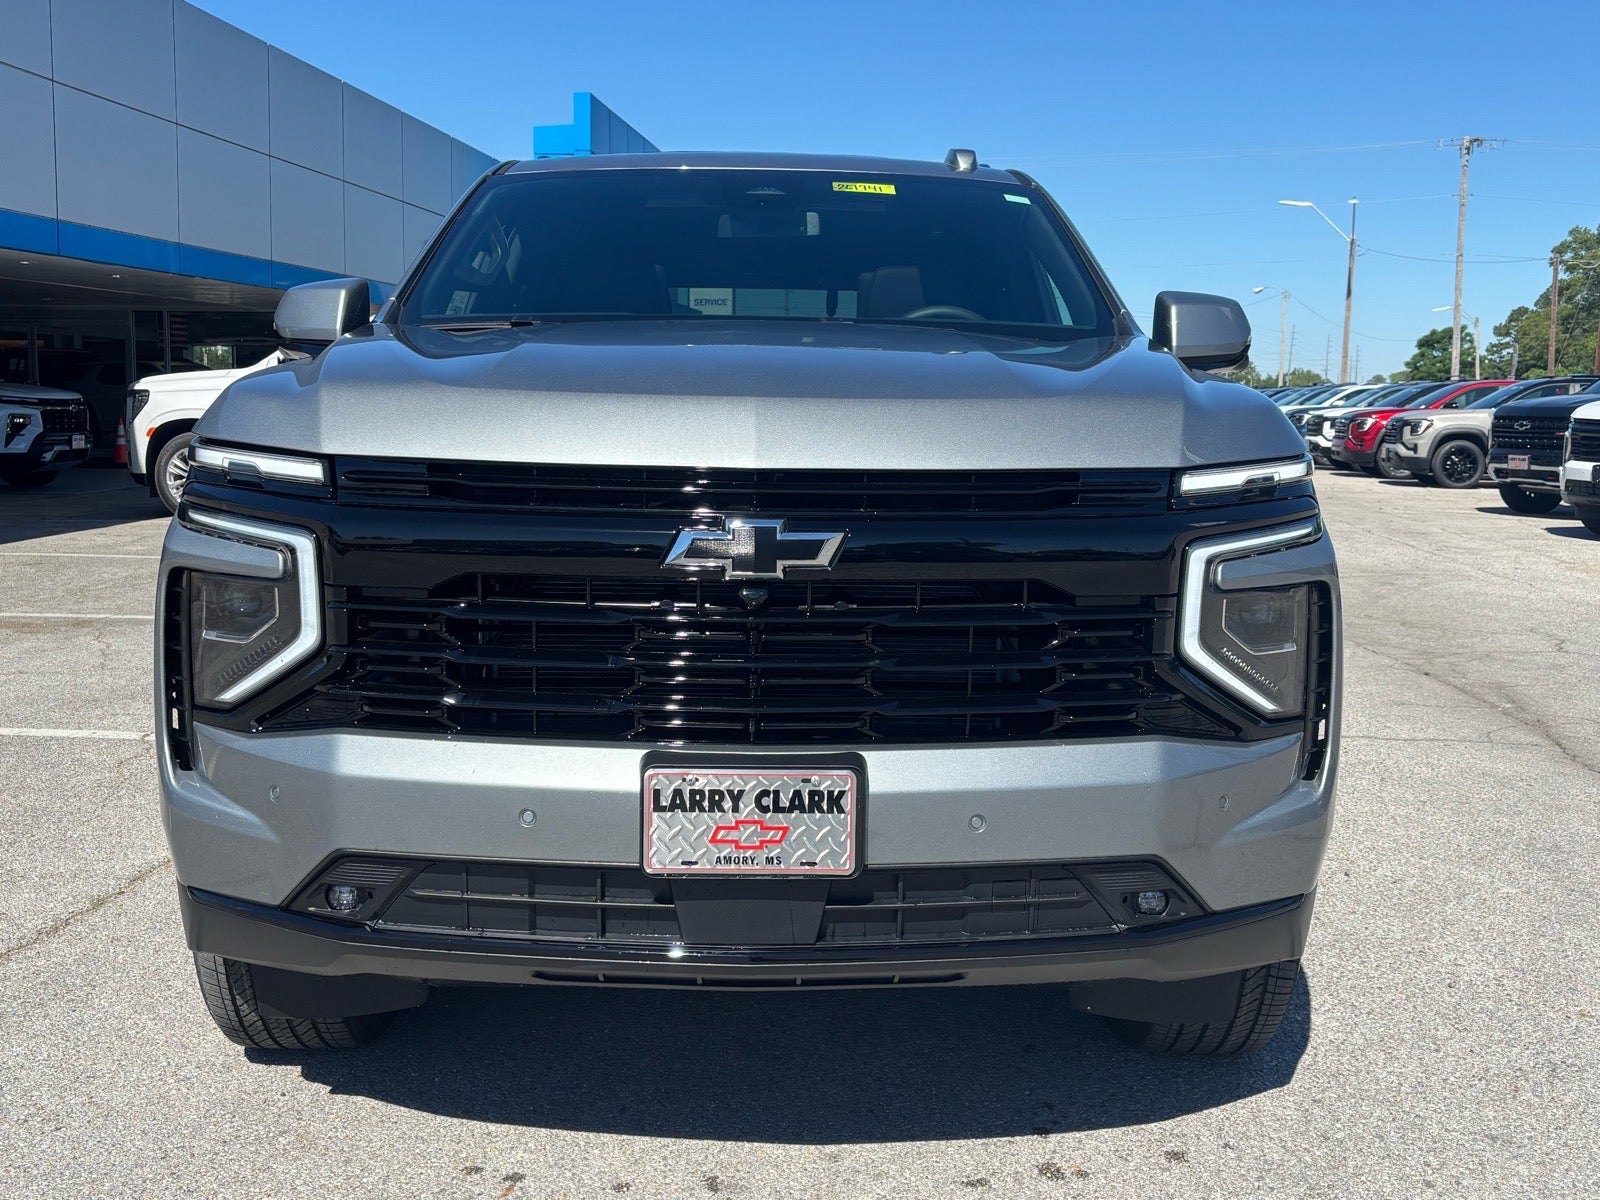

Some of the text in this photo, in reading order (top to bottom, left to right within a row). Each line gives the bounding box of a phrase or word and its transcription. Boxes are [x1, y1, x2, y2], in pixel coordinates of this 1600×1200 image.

[694, 298, 729, 306] SERVICE
[652, 789, 847, 814] LARRY CLARK
[714, 855, 782, 866] AMORY, MS
